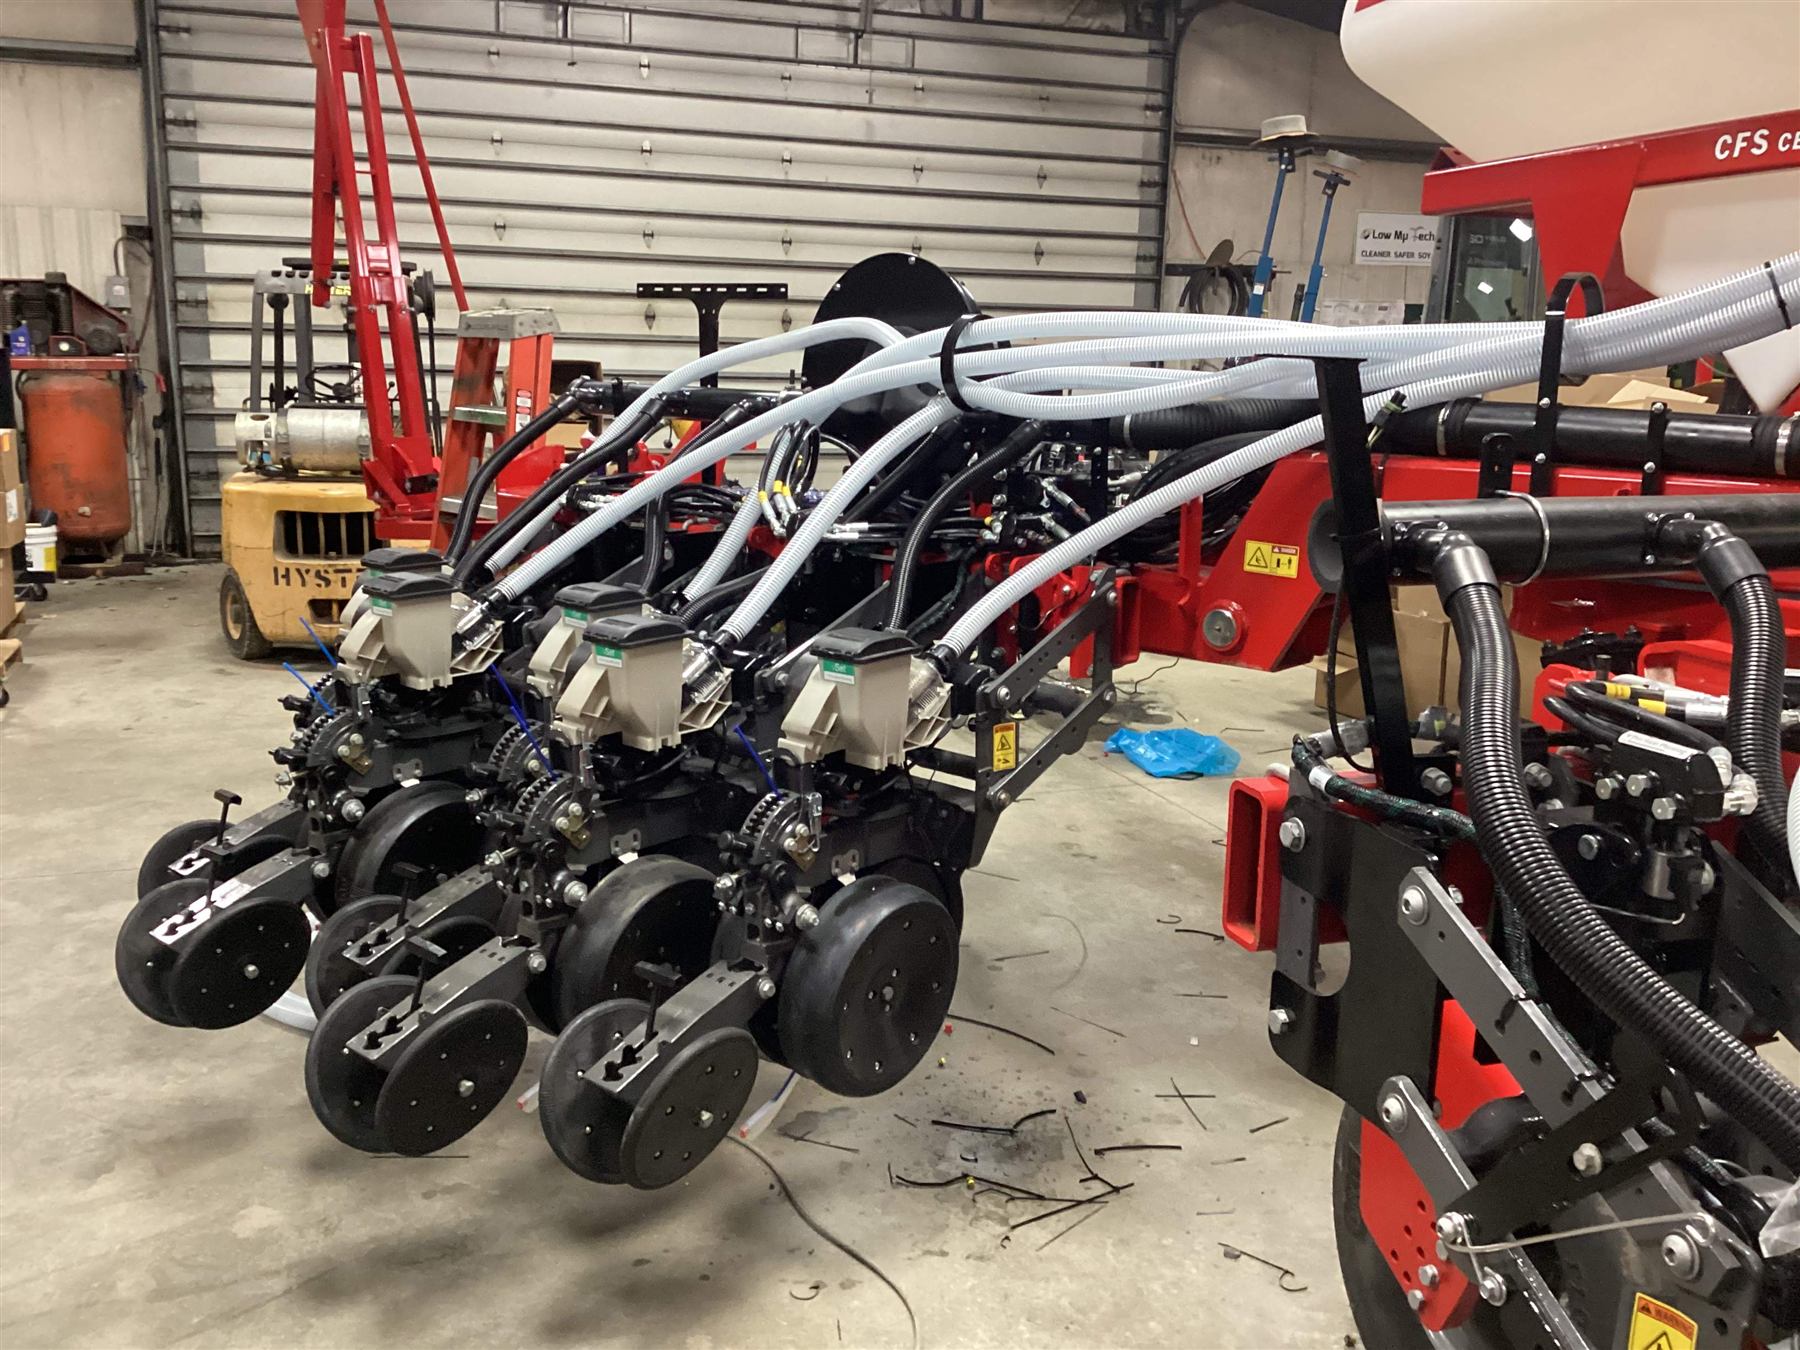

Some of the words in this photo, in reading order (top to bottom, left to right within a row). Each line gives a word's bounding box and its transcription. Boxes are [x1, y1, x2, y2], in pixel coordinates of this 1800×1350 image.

[1714, 128, 1770, 160] CFS
[1372, 229, 1392, 240] Low
[1361, 250, 1391, 258] CLEANER
[1394, 251, 1415, 259] SAFER
